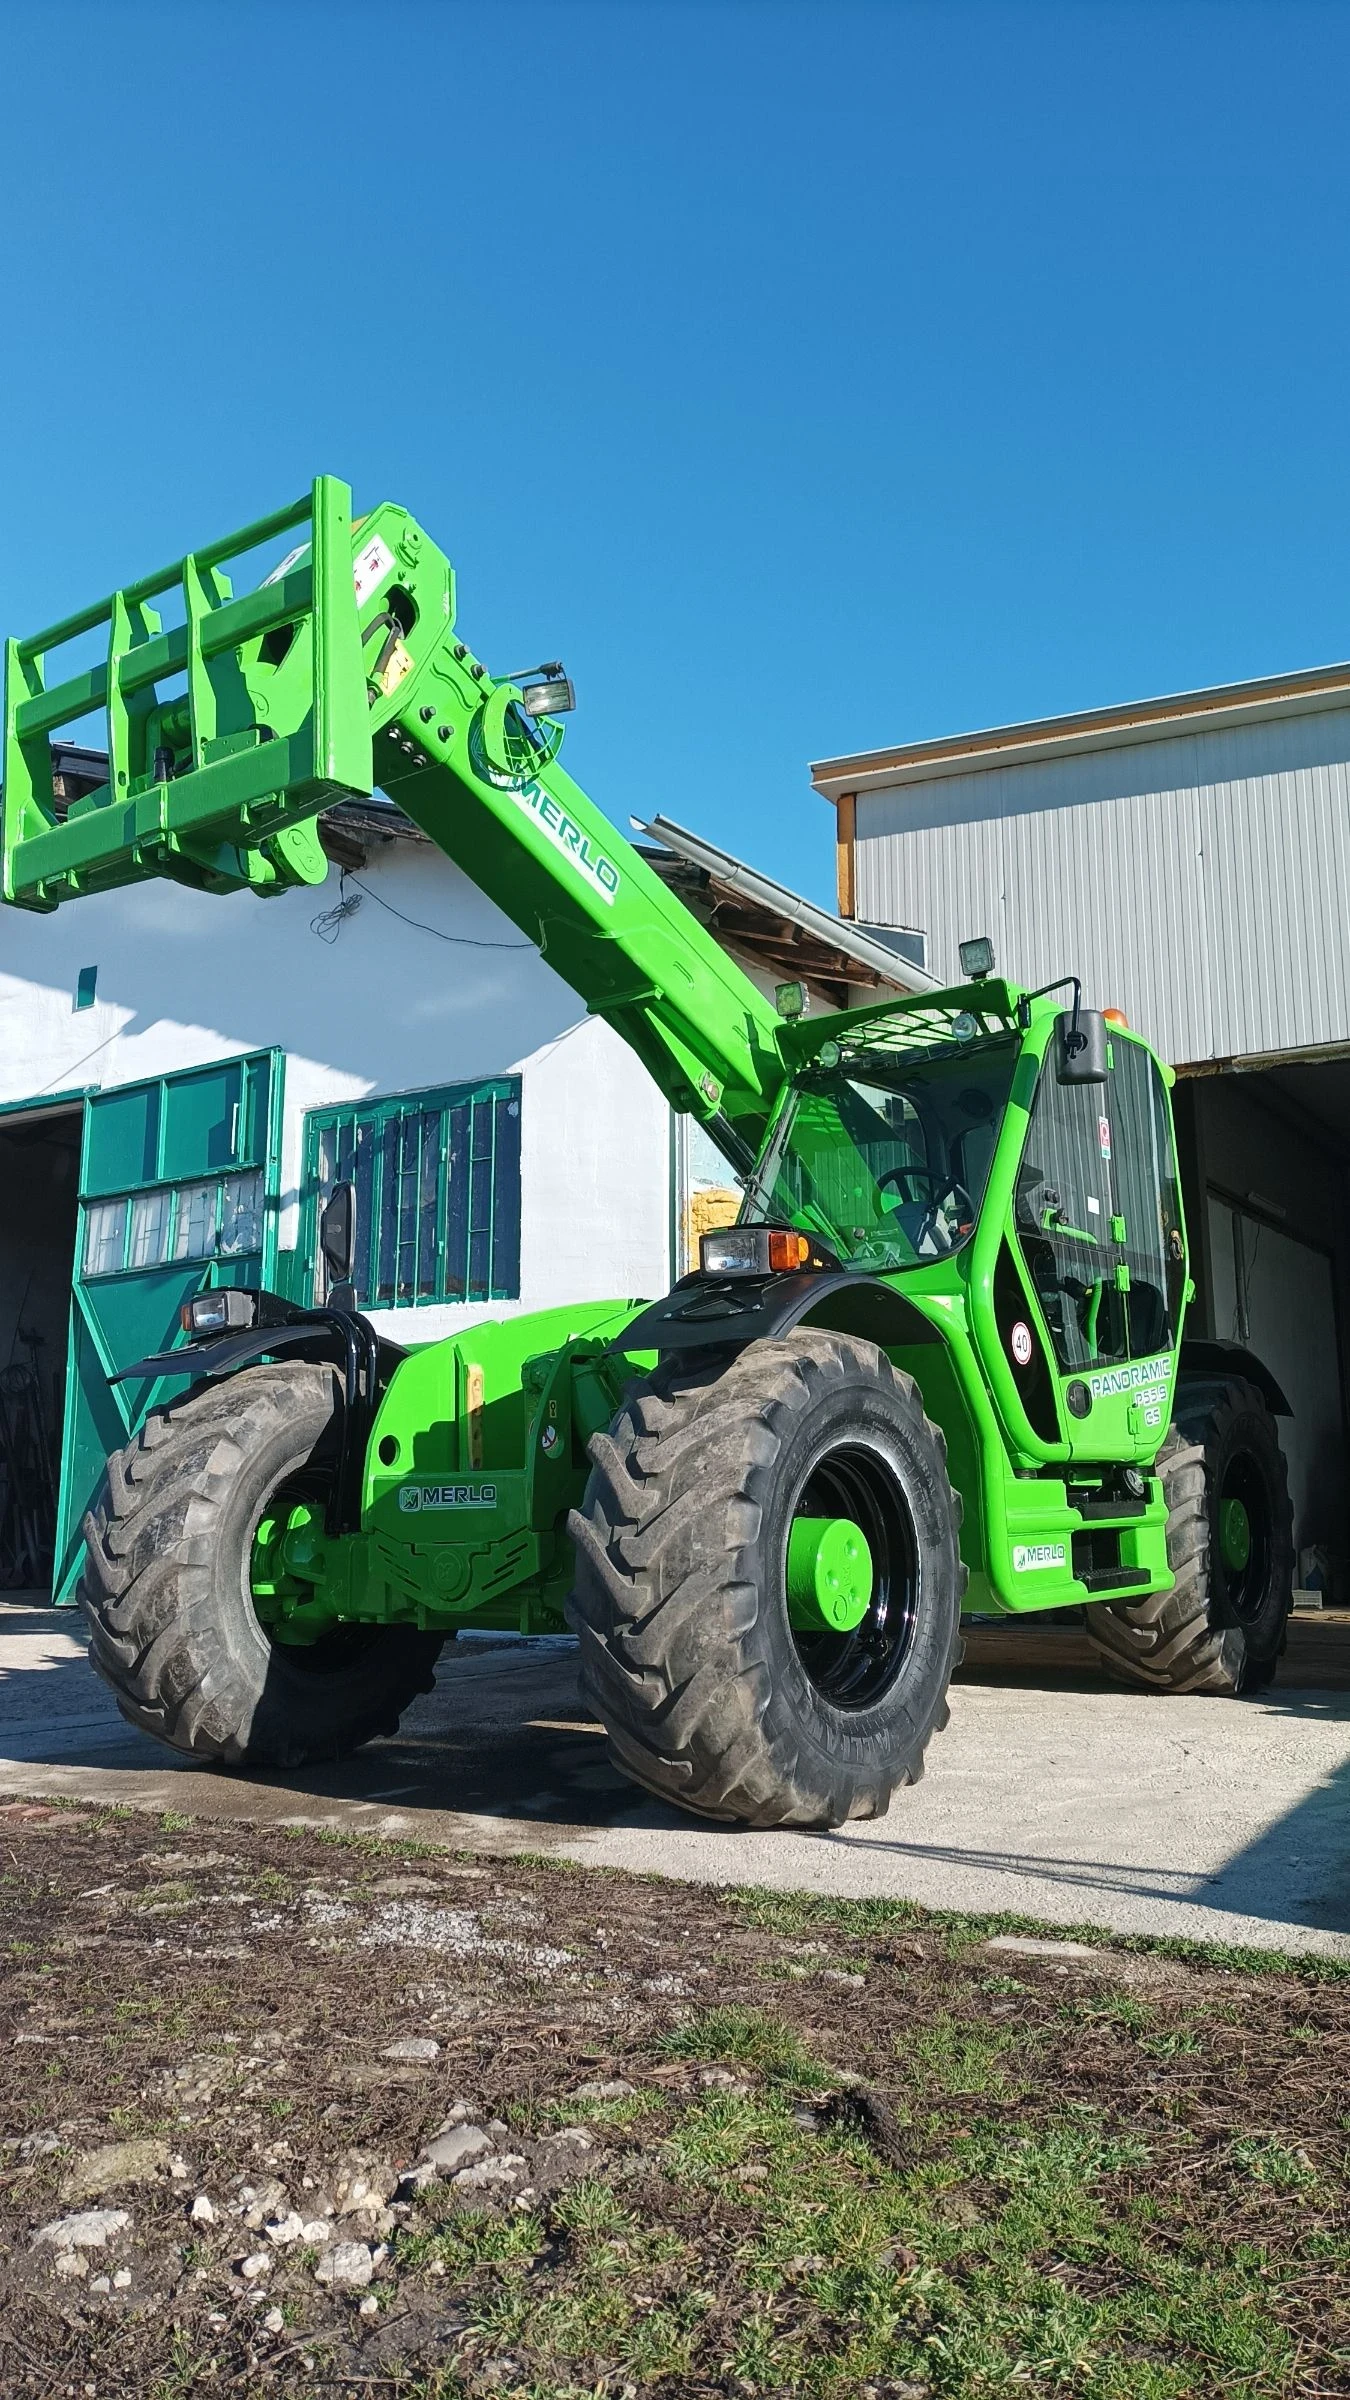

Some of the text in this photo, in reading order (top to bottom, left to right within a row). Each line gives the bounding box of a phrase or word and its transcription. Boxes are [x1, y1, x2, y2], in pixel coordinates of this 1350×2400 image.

[511, 773, 618, 893] MERLO
[1016, 1334, 1028, 1353] 40
[1091, 1358, 1171, 1398] PANORAMIC
[1145, 1408, 1160, 1425] CS
[423, 1484, 497, 1504] MERLO
[1027, 1545, 1065, 1562] MERLO
